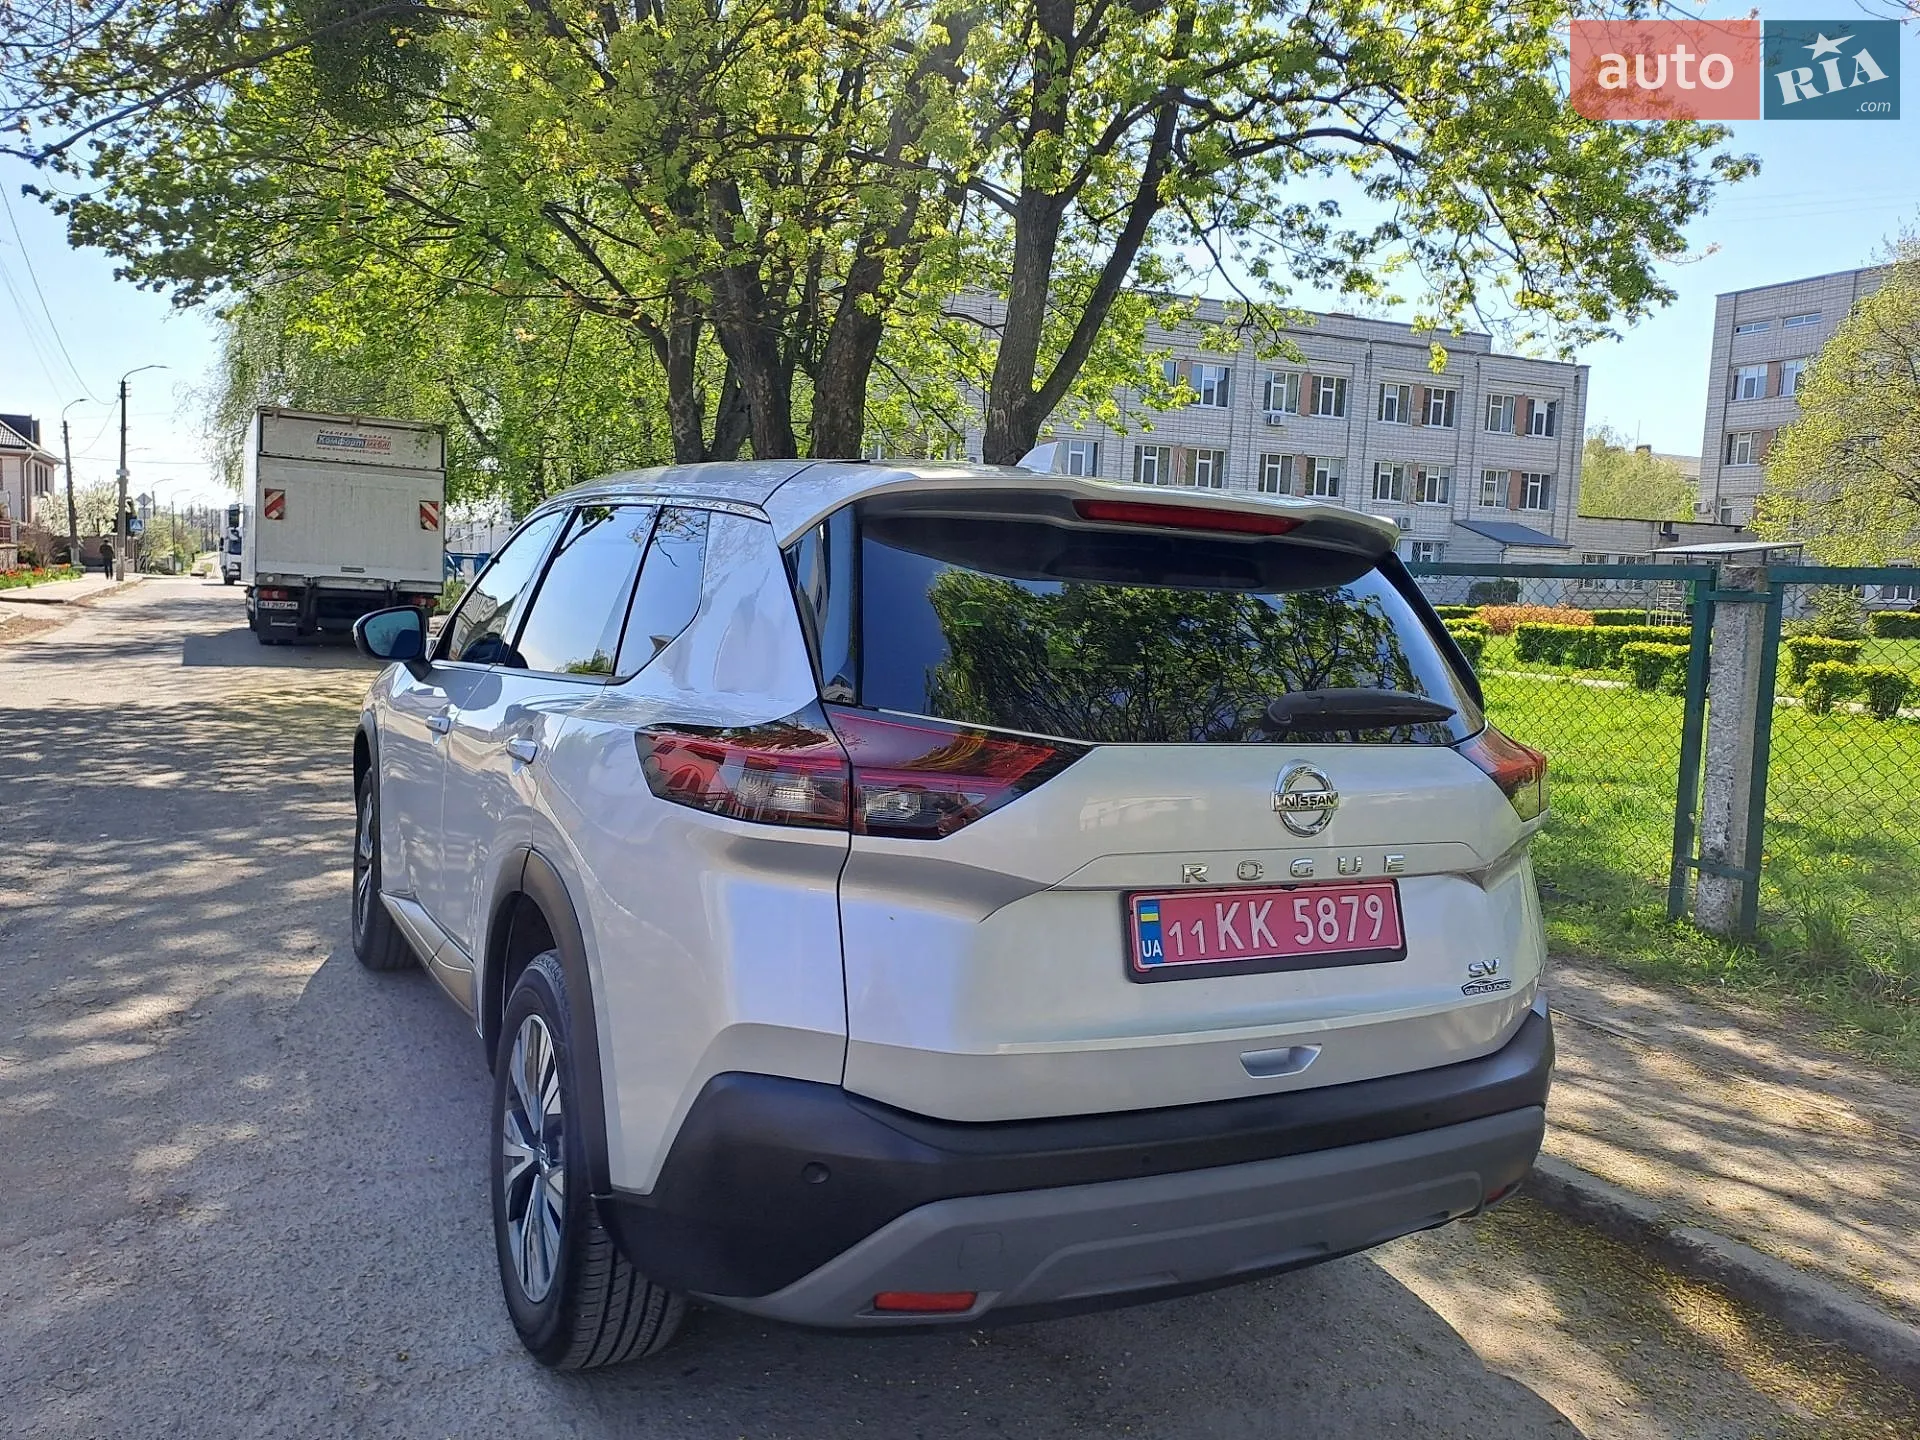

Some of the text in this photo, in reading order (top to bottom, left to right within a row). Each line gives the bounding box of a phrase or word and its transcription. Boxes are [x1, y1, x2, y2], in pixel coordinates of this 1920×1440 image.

[1284, 793, 1334, 807] NISSAN
[1182, 855, 1405, 883] ROGUE
[1294, 895, 1384, 945] 5879
[1141, 939, 1163, 957] UA
[1468, 959, 1500, 978] SV
